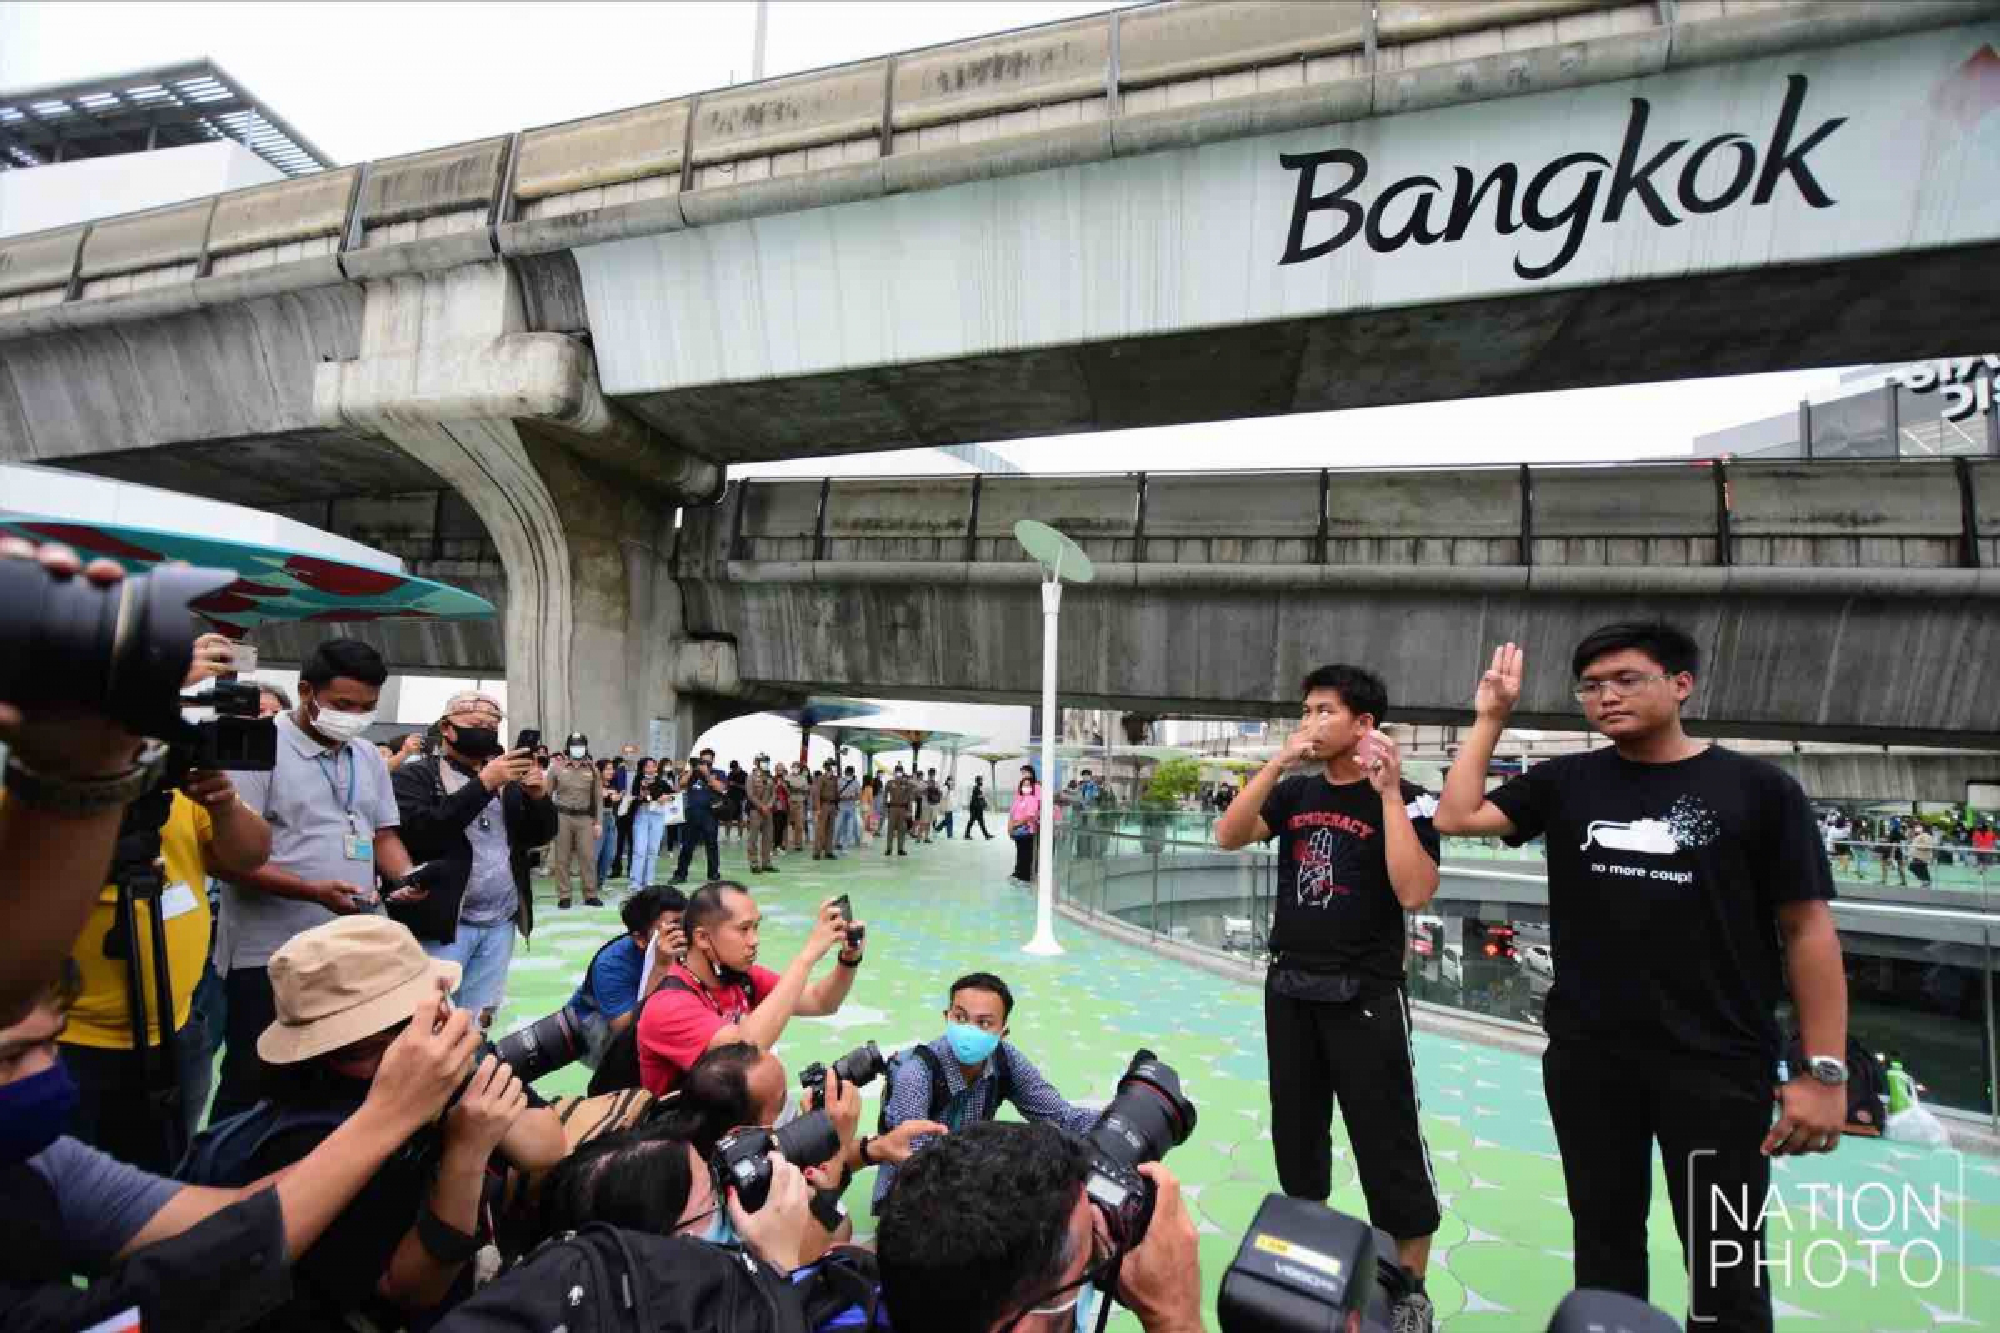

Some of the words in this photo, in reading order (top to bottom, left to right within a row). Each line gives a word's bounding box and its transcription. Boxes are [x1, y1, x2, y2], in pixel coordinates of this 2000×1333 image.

[1278, 74, 1848, 279] Bangkok
[1591, 863, 1606, 872] no
[1609, 865, 1646, 876] more
[1650, 869, 1693, 884] coup!
